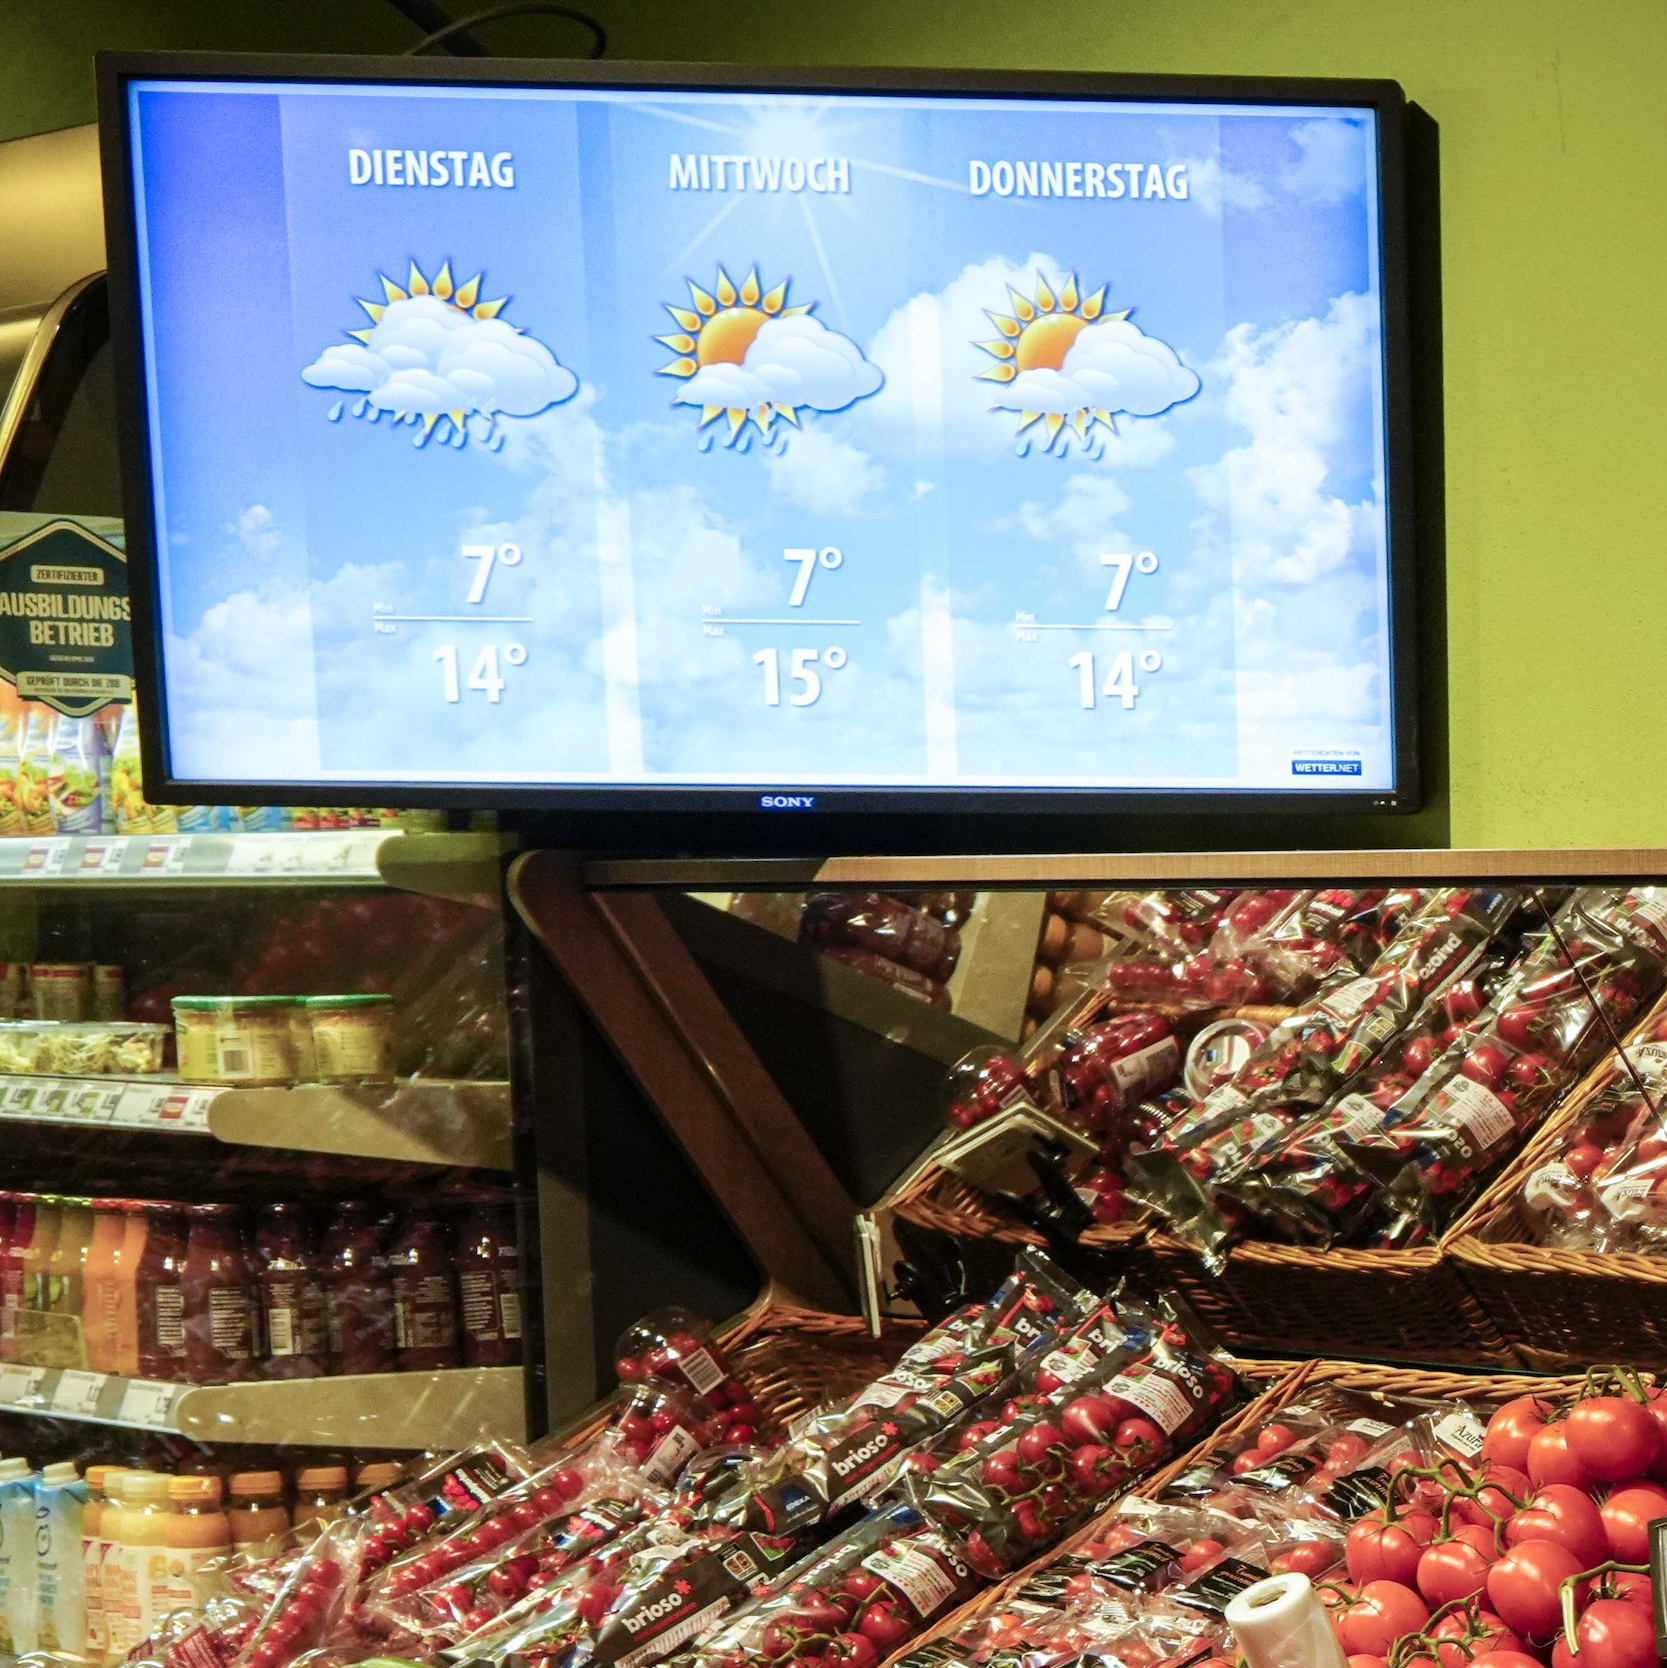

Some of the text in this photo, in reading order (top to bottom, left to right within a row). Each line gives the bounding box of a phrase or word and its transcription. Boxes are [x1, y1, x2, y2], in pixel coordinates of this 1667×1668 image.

[348, 149, 515, 188] DIENSTAG
[669, 153, 850, 193] MITTWOCH
[969, 160, 1188, 199] DONNERSTAG
[461, 543, 523, 603] 7°
[782, 545, 843, 607] 7°
[1100, 551, 1159, 612] 7°
[30, 620, 114, 647] BETRIEB
[432, 642, 527, 703] 14°
[752, 646, 848, 706] 15°
[1068, 649, 1163, 710] 14°
[1295, 763, 1358, 772] WETTER.NET
[761, 796, 814, 807] SONY
[1152, 1357, 1204, 1399] brioso
[831, 1432, 888, 1478] brioso
[1455, 1425, 1483, 1449] Azura
[798, 1544, 859, 1585] brioso
[622, 1591, 683, 1634] brioso
